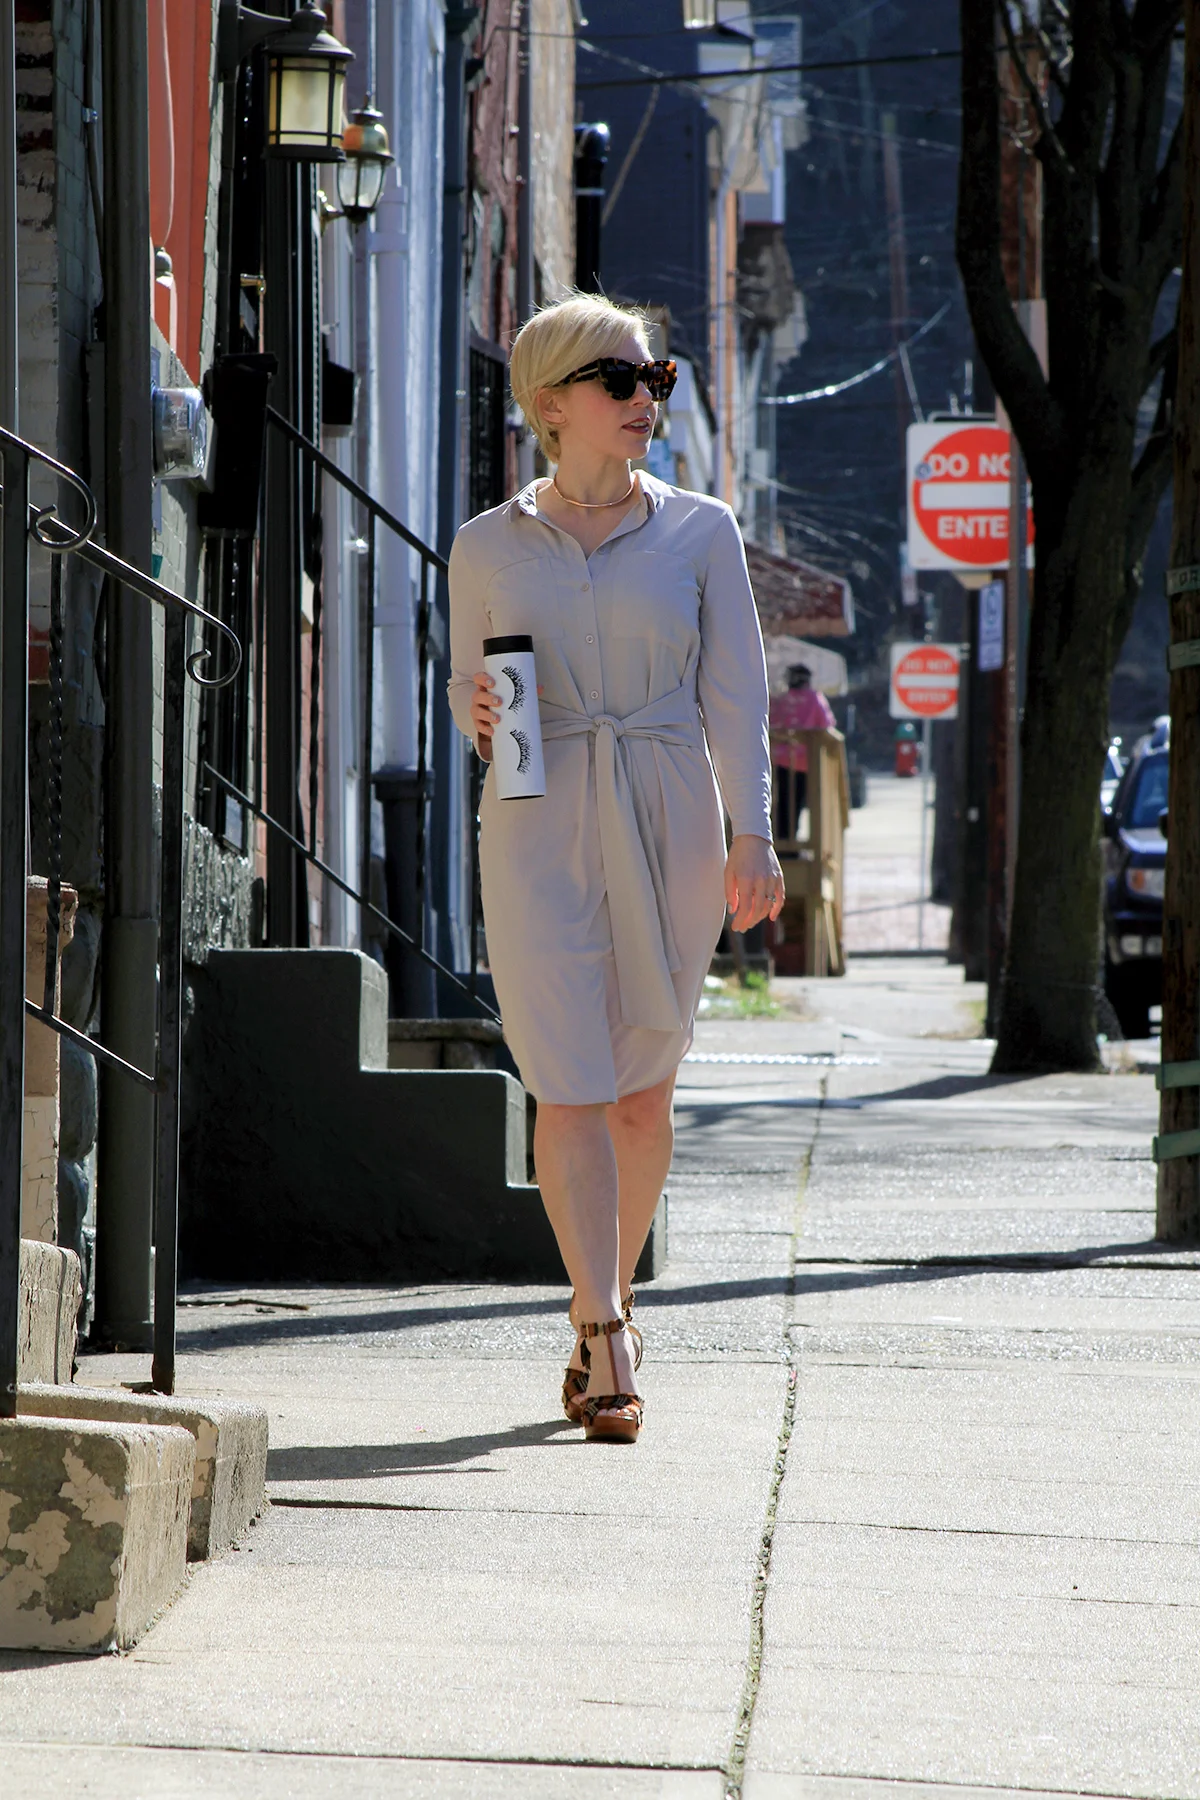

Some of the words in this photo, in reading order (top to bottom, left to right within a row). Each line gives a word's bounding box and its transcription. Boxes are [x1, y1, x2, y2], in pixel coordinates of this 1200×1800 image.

[928, 453, 969, 477] DO
[978, 453, 1010, 476] NO
[937, 515, 1008, 539] ENTE
